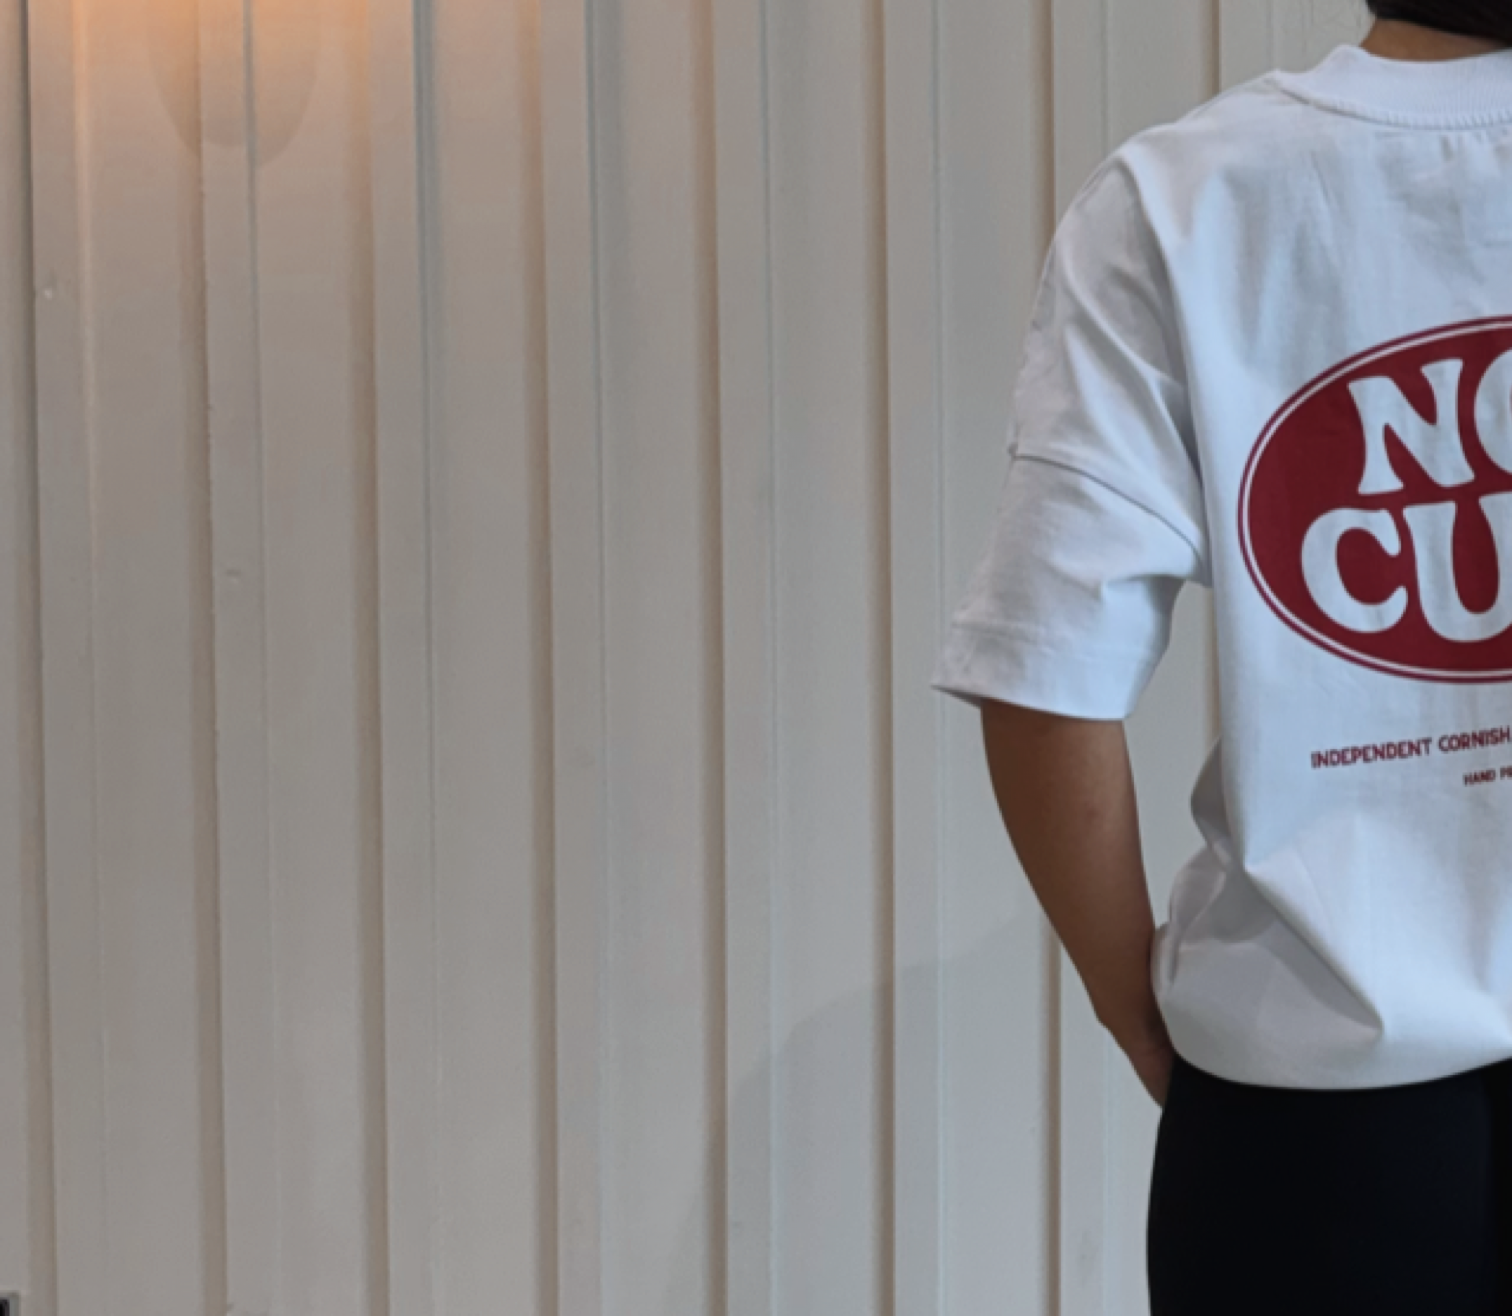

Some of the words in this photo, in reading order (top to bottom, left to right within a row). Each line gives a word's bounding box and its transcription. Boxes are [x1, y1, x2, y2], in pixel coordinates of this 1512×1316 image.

[1311, 737, 1432, 769] INDEPENDENT
[1438, 727, 1512, 753] CORNISH
[1463, 769, 1496, 786] HAND
